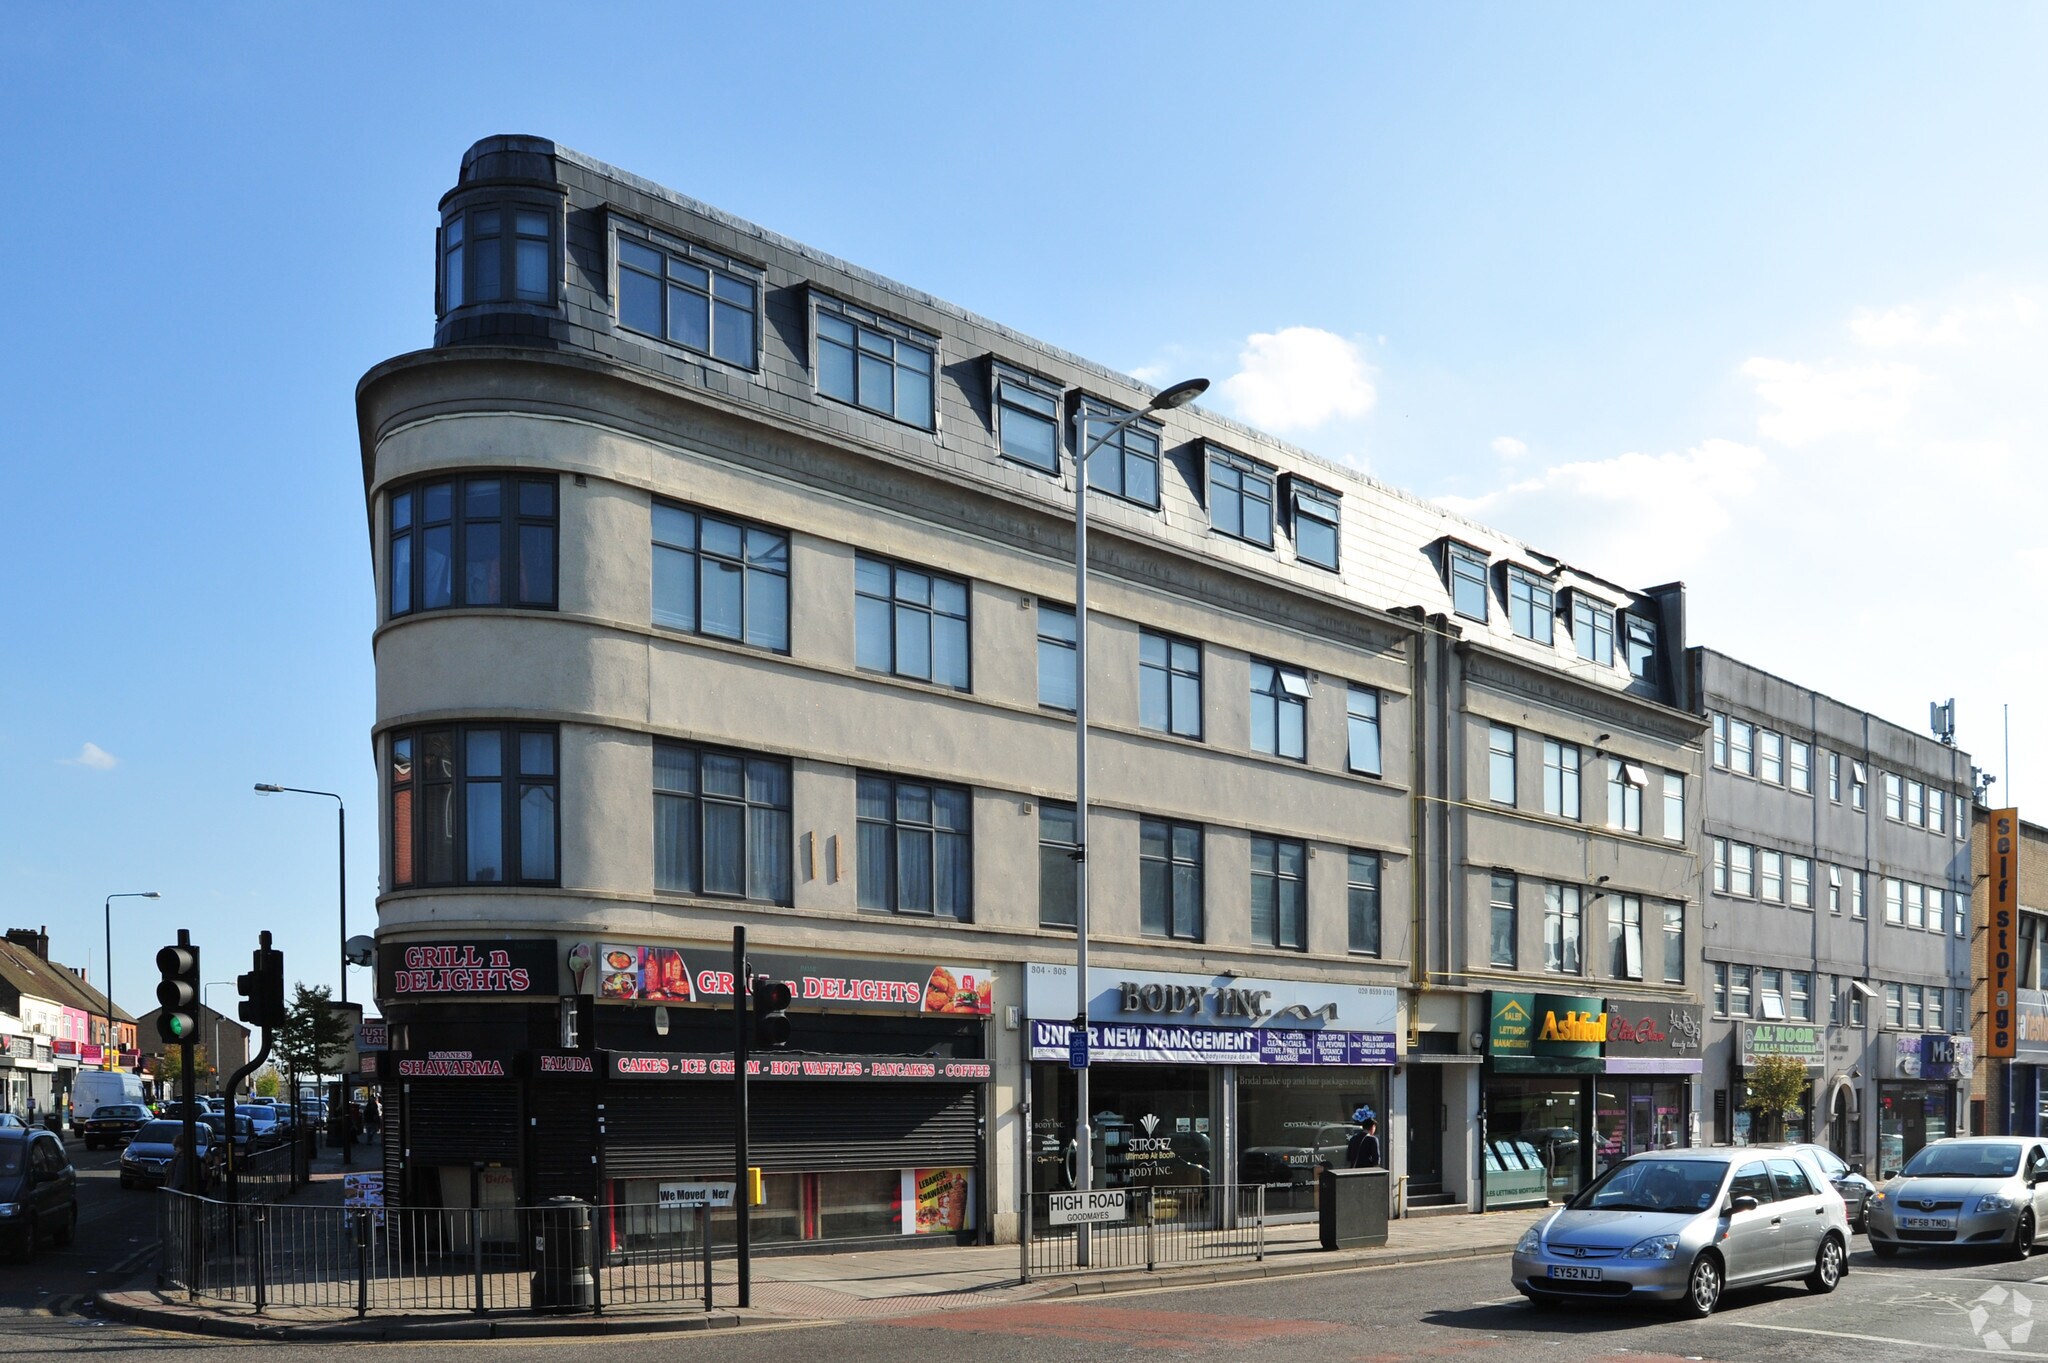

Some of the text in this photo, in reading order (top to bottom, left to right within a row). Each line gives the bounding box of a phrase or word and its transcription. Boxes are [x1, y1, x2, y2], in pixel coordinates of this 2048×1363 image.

[1996, 817, 2010, 902] self
[405, 946, 510, 969] GRILL n
[395, 968, 530, 992] DELIGHTS
[1995, 910, 2010, 1049] storage
[803, 976, 921, 1004] DELIGHTS
[1120, 981, 1272, 1017] BODY INC
[1504, 1011, 1522, 1021] SALES
[361, 1027, 384, 1036] JUST
[366, 1036, 384, 1044] EAT
[1103, 1027, 1147, 1048] NEW
[1146, 1028, 1254, 1051] MANAGEMENT
[1316, 1041, 1325, 1049] ALL
[1493, 1039, 1530, 1049] MANAGEMENT
[1262, 1046, 1281, 1054] RECEIVE
[1299, 1047, 1312, 1055] BACK
[541, 1055, 593, 1072] FALUDA
[1275, 1054, 1299, 1062] MASSAGE
[399, 1060, 504, 1076] SHAWARMA
[618, 1057, 669, 1074] CAKES
[681, 1058, 707, 1074] ICE
[709, 1059, 760, 1075] CREM
[770, 1061, 801, 1075] HOT
[802, 1061, 863, 1076] WAFFLES
[871, 1062, 936, 1077] PANCAKES
[945, 1063, 991, 1078] COFFEE
[1125, 1150, 1176, 1161] Ultimate Air Booth
[1290, 1153, 1327, 1164] BODY INC.
[1129, 1166, 1173, 1177] BODY INC.
[918, 1170, 947, 1190] LEBANESE
[660, 1190, 676, 1201] We
[676, 1188, 706, 1201] Moved
[918, 1181, 953, 1204] SHAWARMA
[1496, 1188, 1518, 1197] LETTINGS
[1050, 1193, 1124, 1212] HIGH ROAD
[1066, 1211, 1110, 1222] GOODMAYES
[1553, 1266, 1601, 1280] EY52 NJJ
